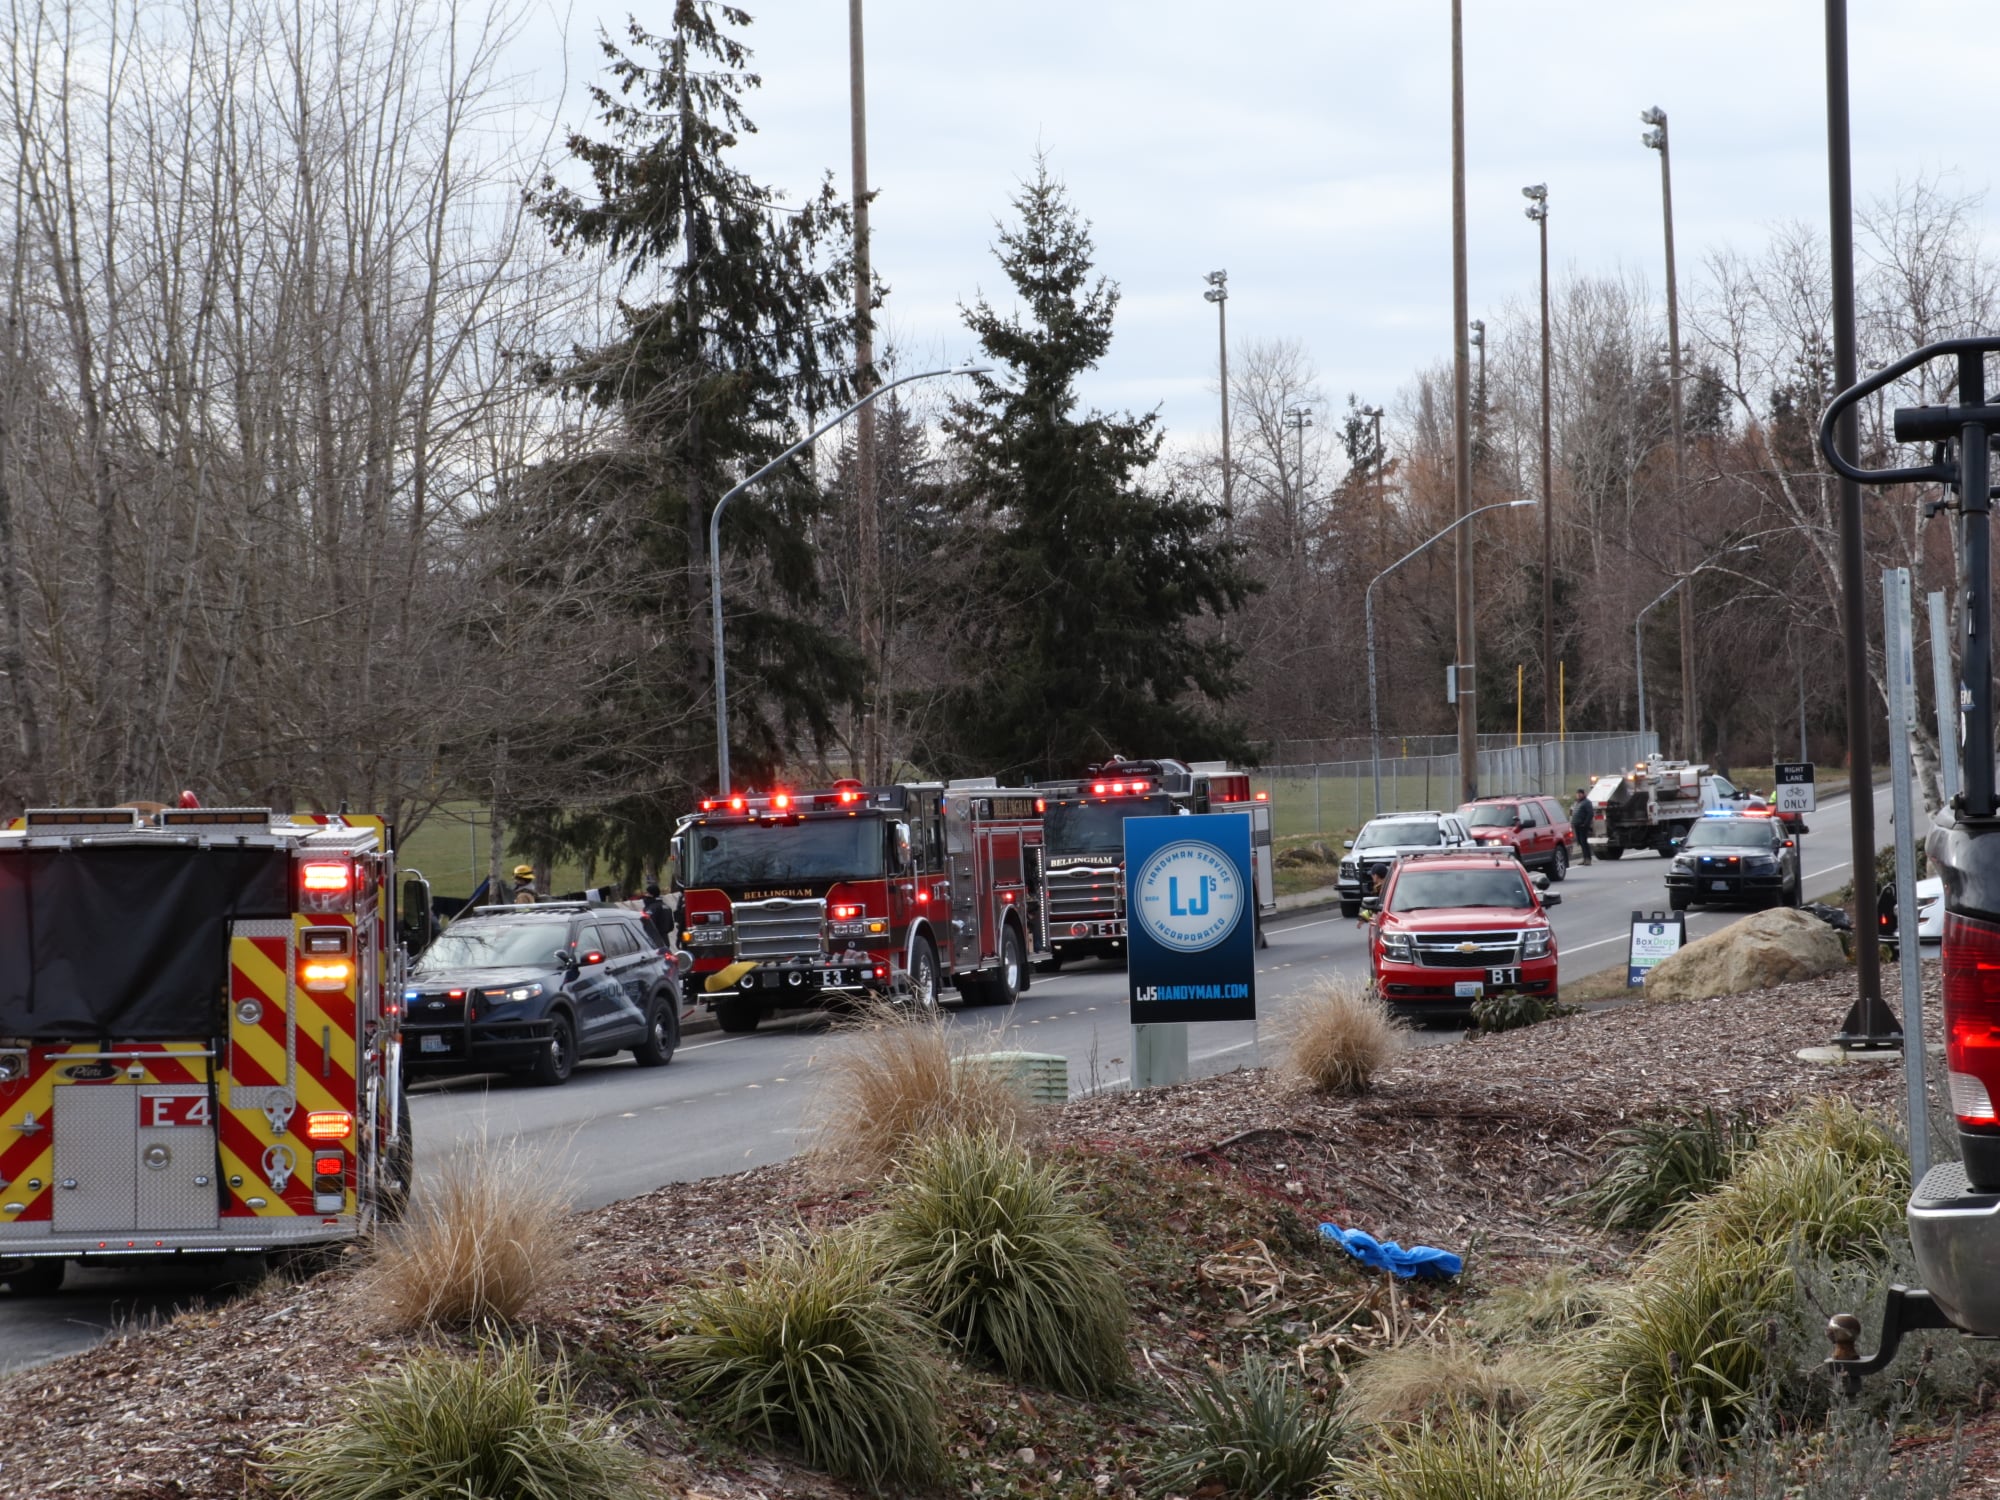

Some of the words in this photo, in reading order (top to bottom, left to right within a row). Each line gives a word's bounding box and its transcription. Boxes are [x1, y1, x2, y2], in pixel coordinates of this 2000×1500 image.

[1785, 774, 1804, 782] LANE
[1783, 799, 1807, 809] ONLY
[1050, 856, 1112, 868] BELLINGHAM
[1147, 850, 1193, 886] HANDYMAN
[1197, 851, 1231, 884] SERVICE
[743, 888, 813, 900] BELLINGHAM
[1098, 922, 1115, 936] E1
[1155, 917, 1225, 942] INCORPORATED
[822, 970, 842, 986] E3
[1491, 967, 1516, 985] B1
[1136, 983, 1249, 1002] LJSHANDYMAN.COM
